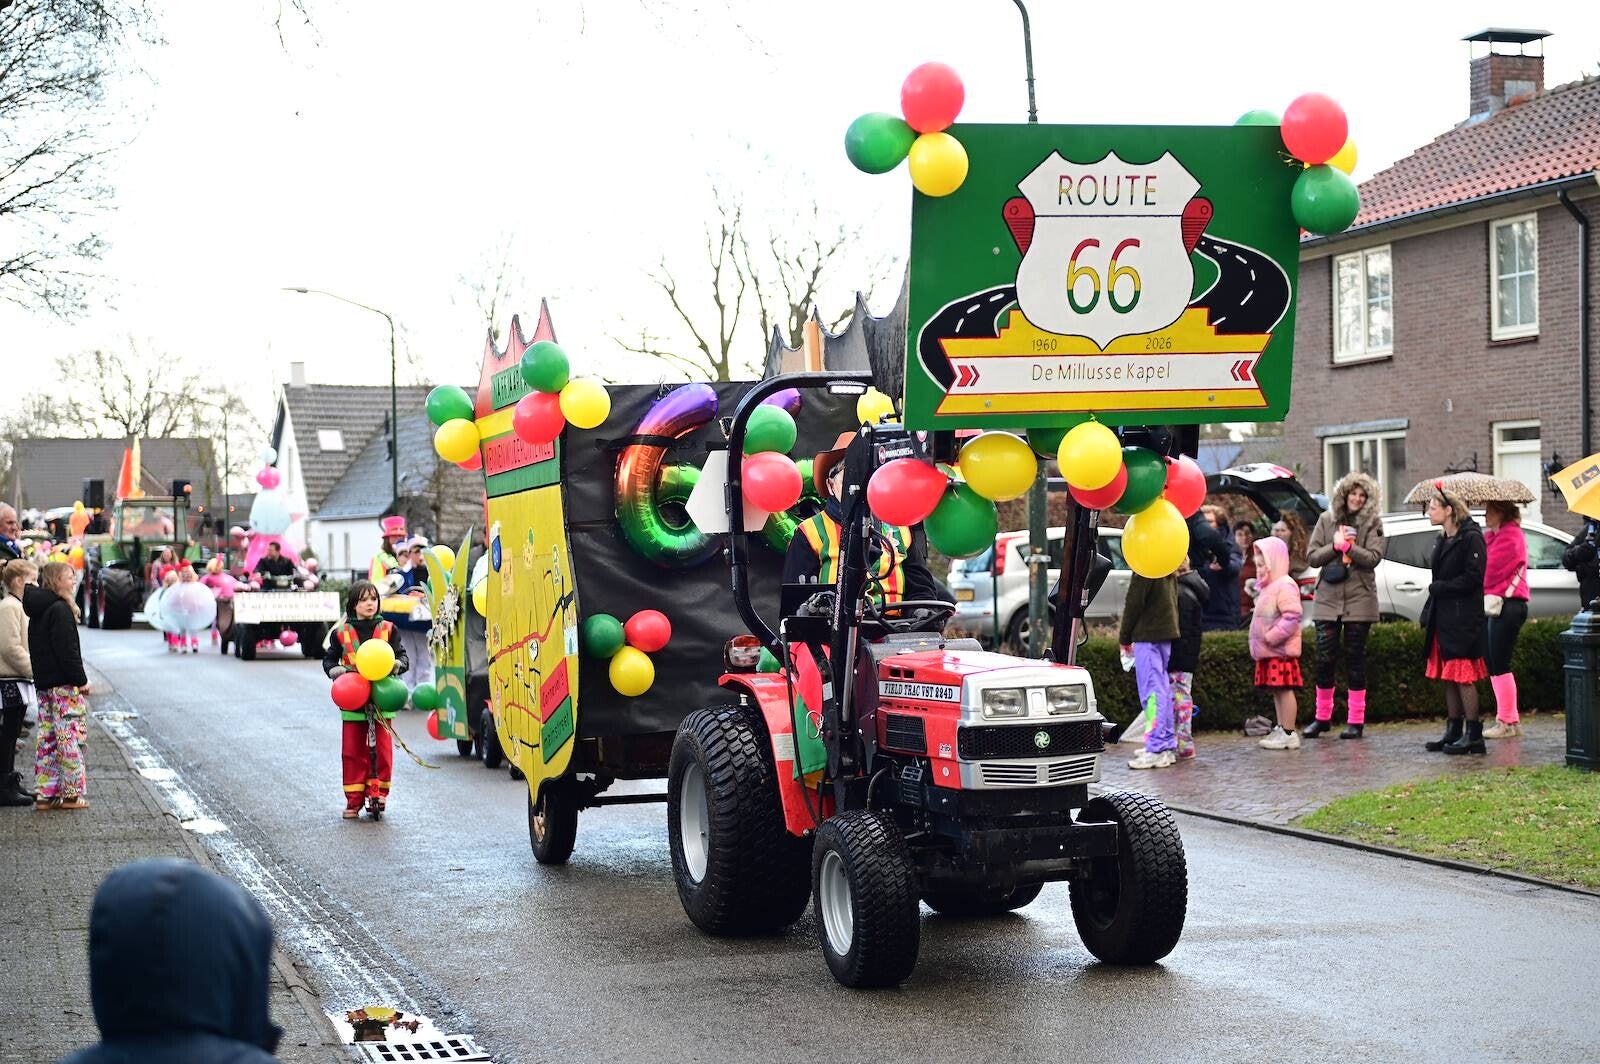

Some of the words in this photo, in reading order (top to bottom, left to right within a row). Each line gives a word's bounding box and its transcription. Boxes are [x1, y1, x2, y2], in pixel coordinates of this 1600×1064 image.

[1058, 174, 1157, 206] ROUTE
[1066, 237, 1141, 315] 66
[1031, 338, 1058, 352] 1960
[1145, 337, 1173, 351] 2026
[1032, 363, 1054, 381] De
[1057, 362, 1122, 380] Millusse
[1126, 361, 1171, 384] Kapel
[884, 682, 903, 695] FIELD
[904, 683, 921, 697] TRAC
[921, 685, 935, 698] VST
[935, 686, 954, 700] 224D
